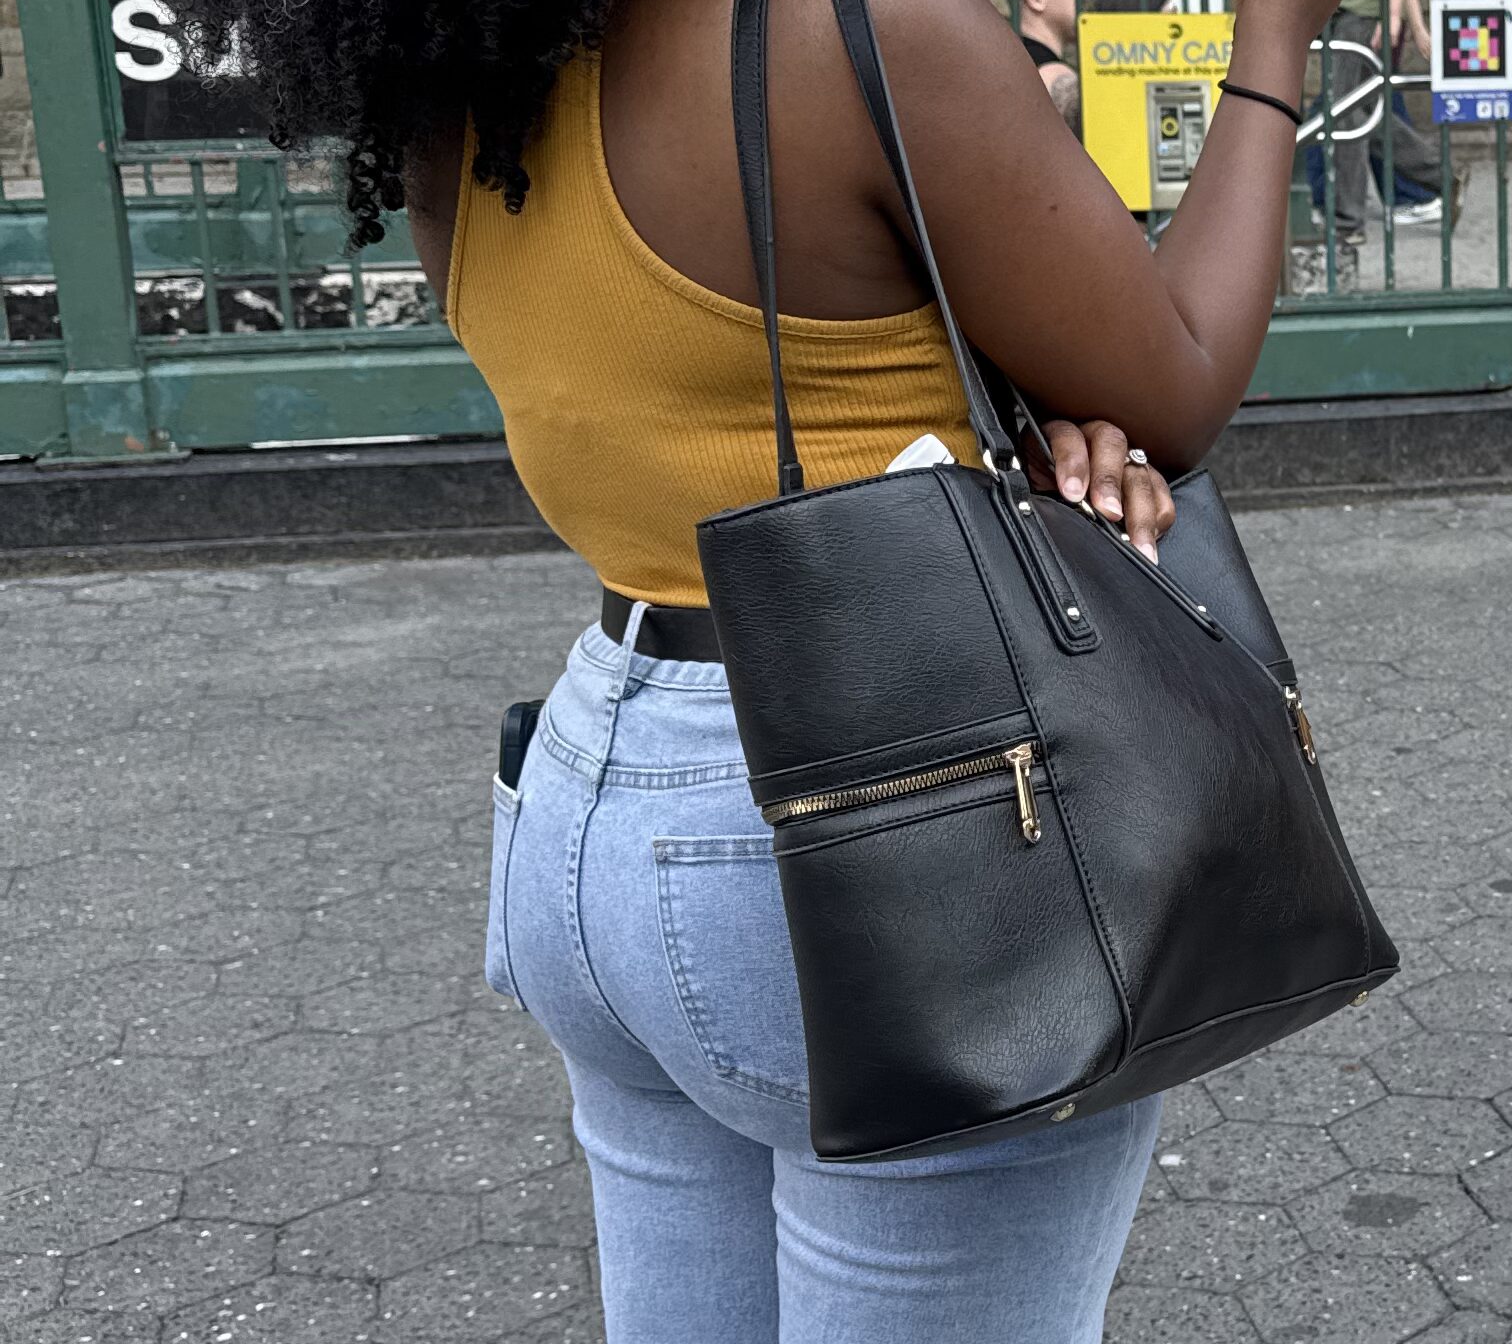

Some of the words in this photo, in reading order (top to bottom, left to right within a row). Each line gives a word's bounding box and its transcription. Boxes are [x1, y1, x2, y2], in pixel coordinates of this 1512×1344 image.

[1093, 41, 1175, 65] OMNY
[1095, 67, 1136, 77] vending
[1138, 67, 1180, 75] machine
[1183, 67, 1191, 75] at
[1194, 65, 1212, 74] this
